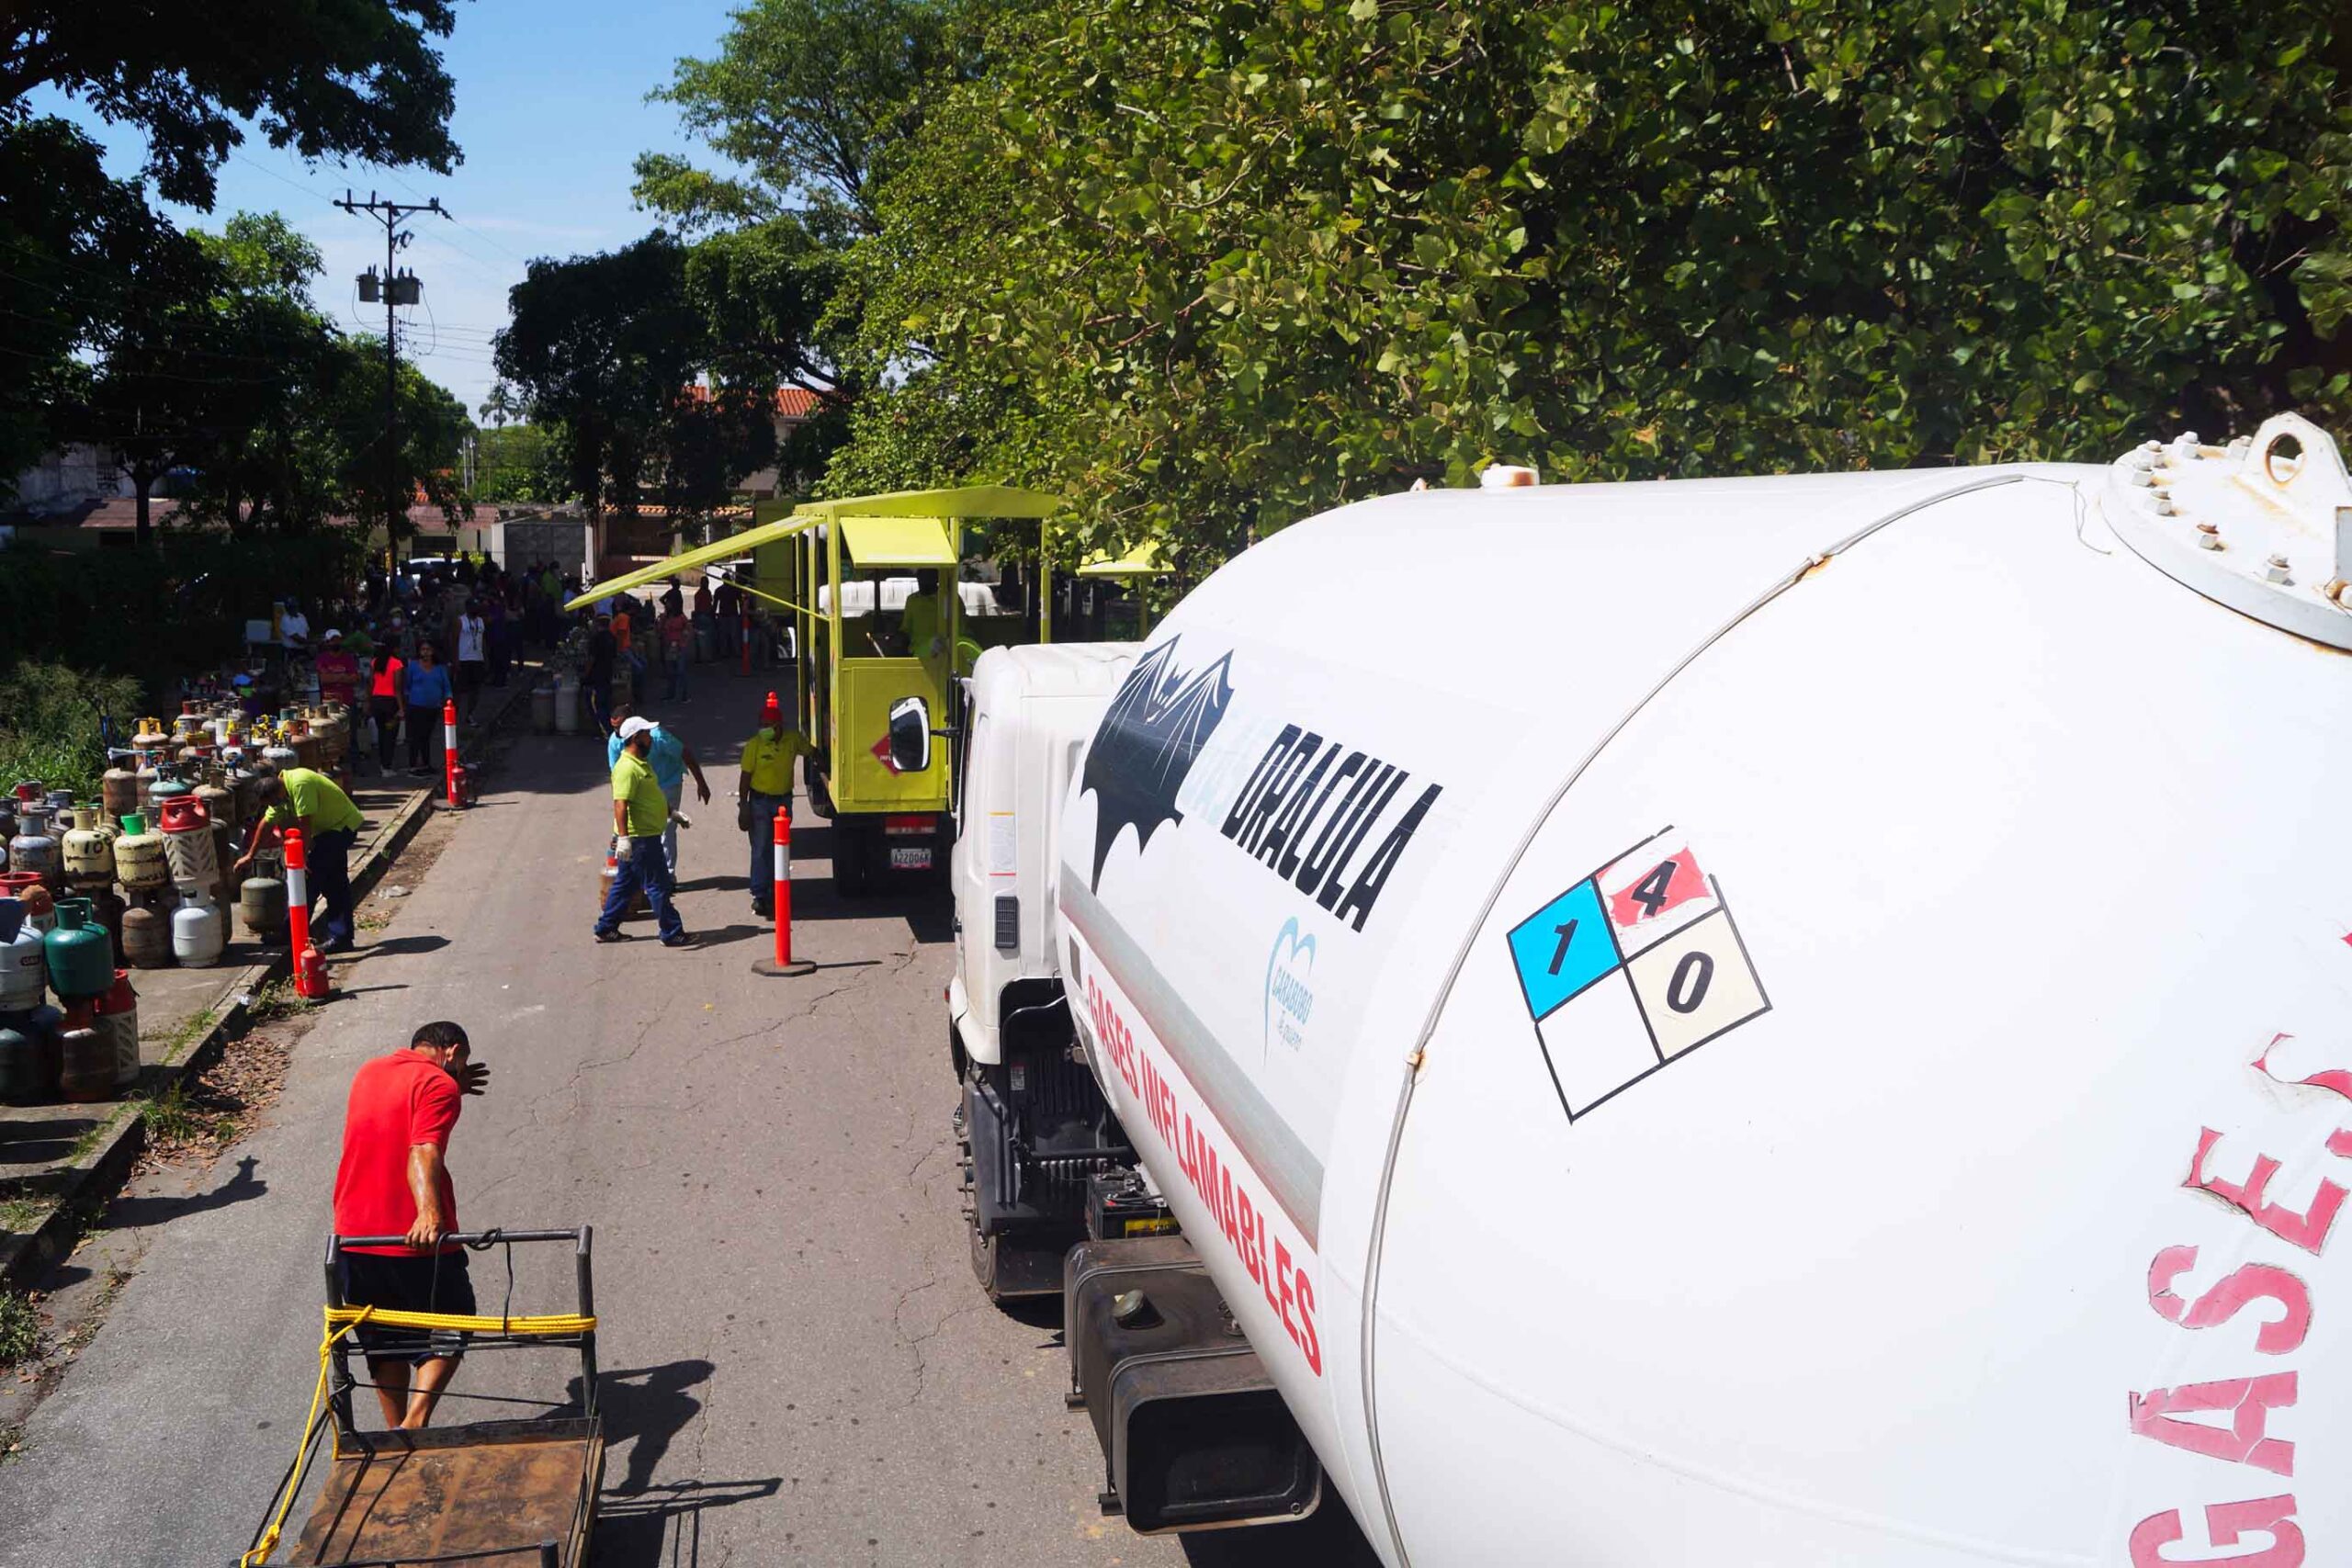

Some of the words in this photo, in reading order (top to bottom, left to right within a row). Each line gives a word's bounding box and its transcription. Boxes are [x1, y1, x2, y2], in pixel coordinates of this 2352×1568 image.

[1220, 723, 1444, 933] DRACULA
[1631, 861, 1678, 917] 4
[1547, 918, 1578, 976] 1
[1272, 965, 1313, 1025] CARABOBO
[1666, 951, 1714, 1014] 0
[1088, 974, 1139, 1100] GASES
[1139, 1050, 1322, 1378] INFLAMABLES
